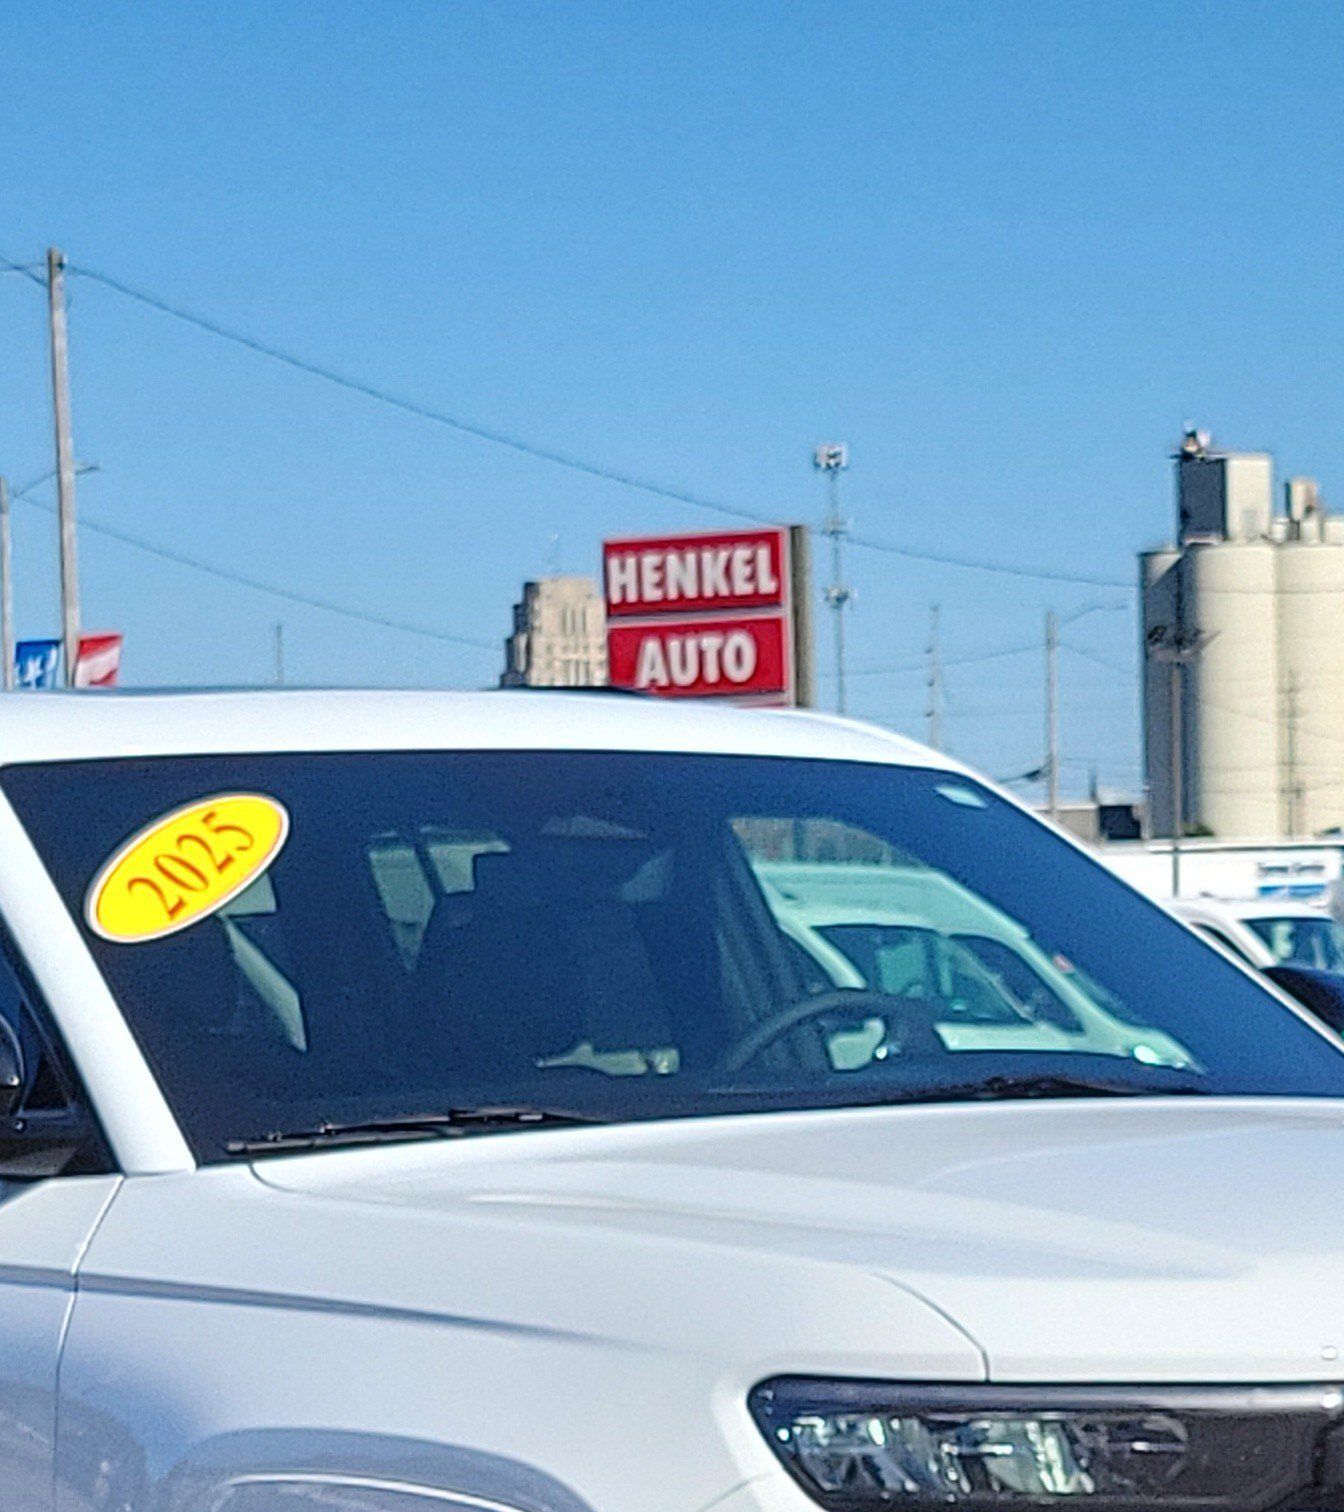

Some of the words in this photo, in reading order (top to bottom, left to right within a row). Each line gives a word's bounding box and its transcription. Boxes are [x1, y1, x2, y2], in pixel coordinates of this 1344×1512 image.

[607, 545, 778, 605] HENKEL
[636, 632, 757, 690] AUTO
[127, 811, 255, 921] 2025
